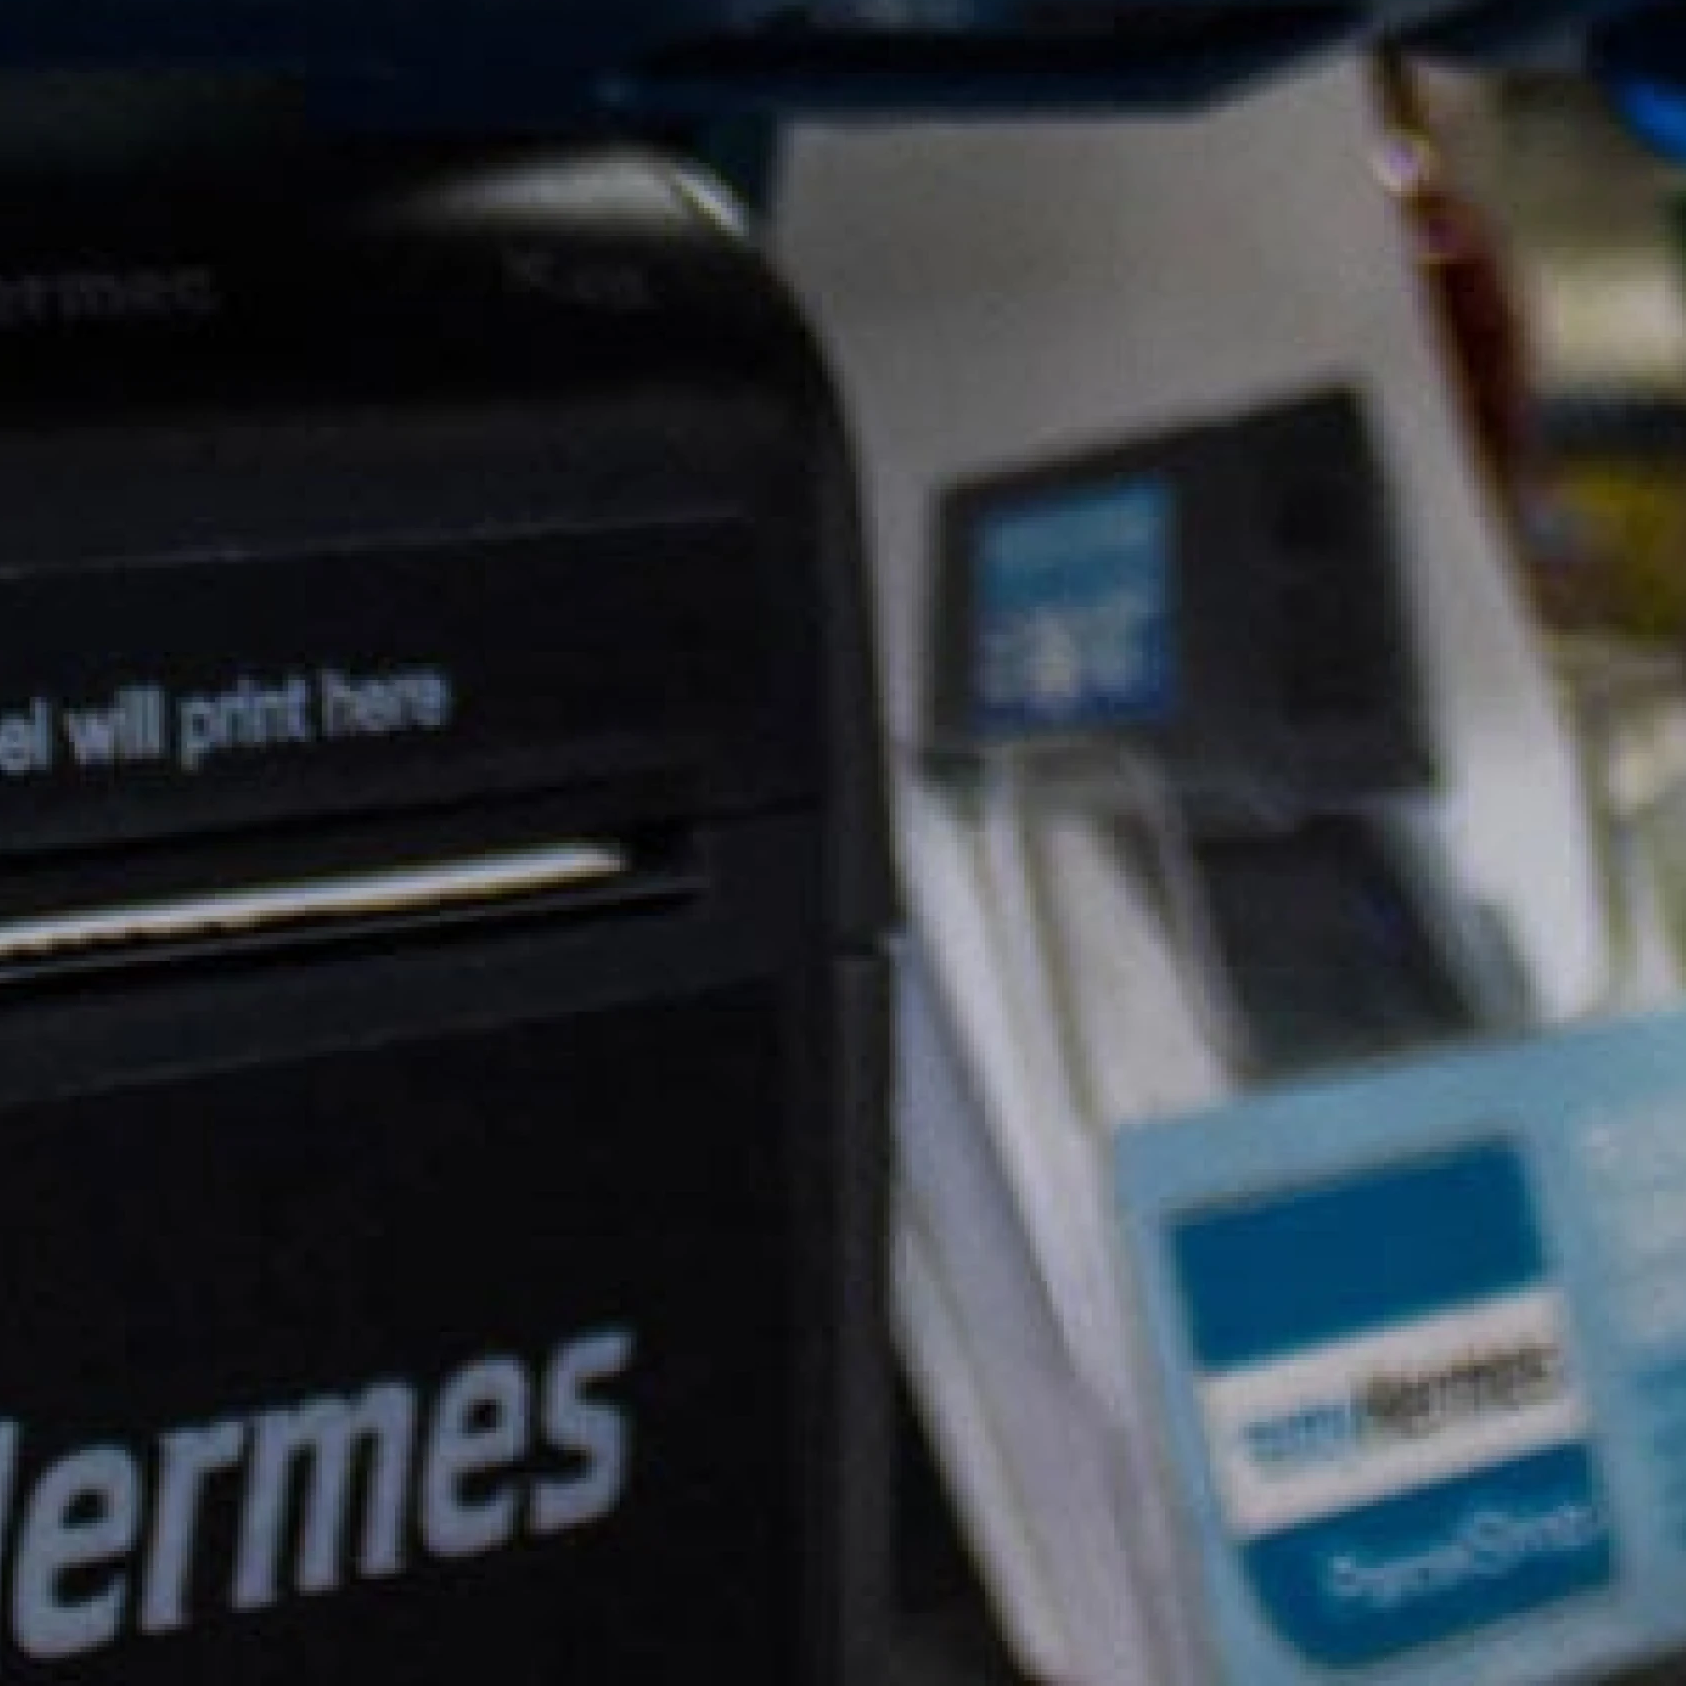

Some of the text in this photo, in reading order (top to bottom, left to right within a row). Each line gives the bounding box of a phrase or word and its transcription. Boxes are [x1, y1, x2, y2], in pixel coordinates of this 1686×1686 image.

[65, 680, 165, 770] will
[179, 672, 311, 770] print
[319, 664, 455, 738] here
